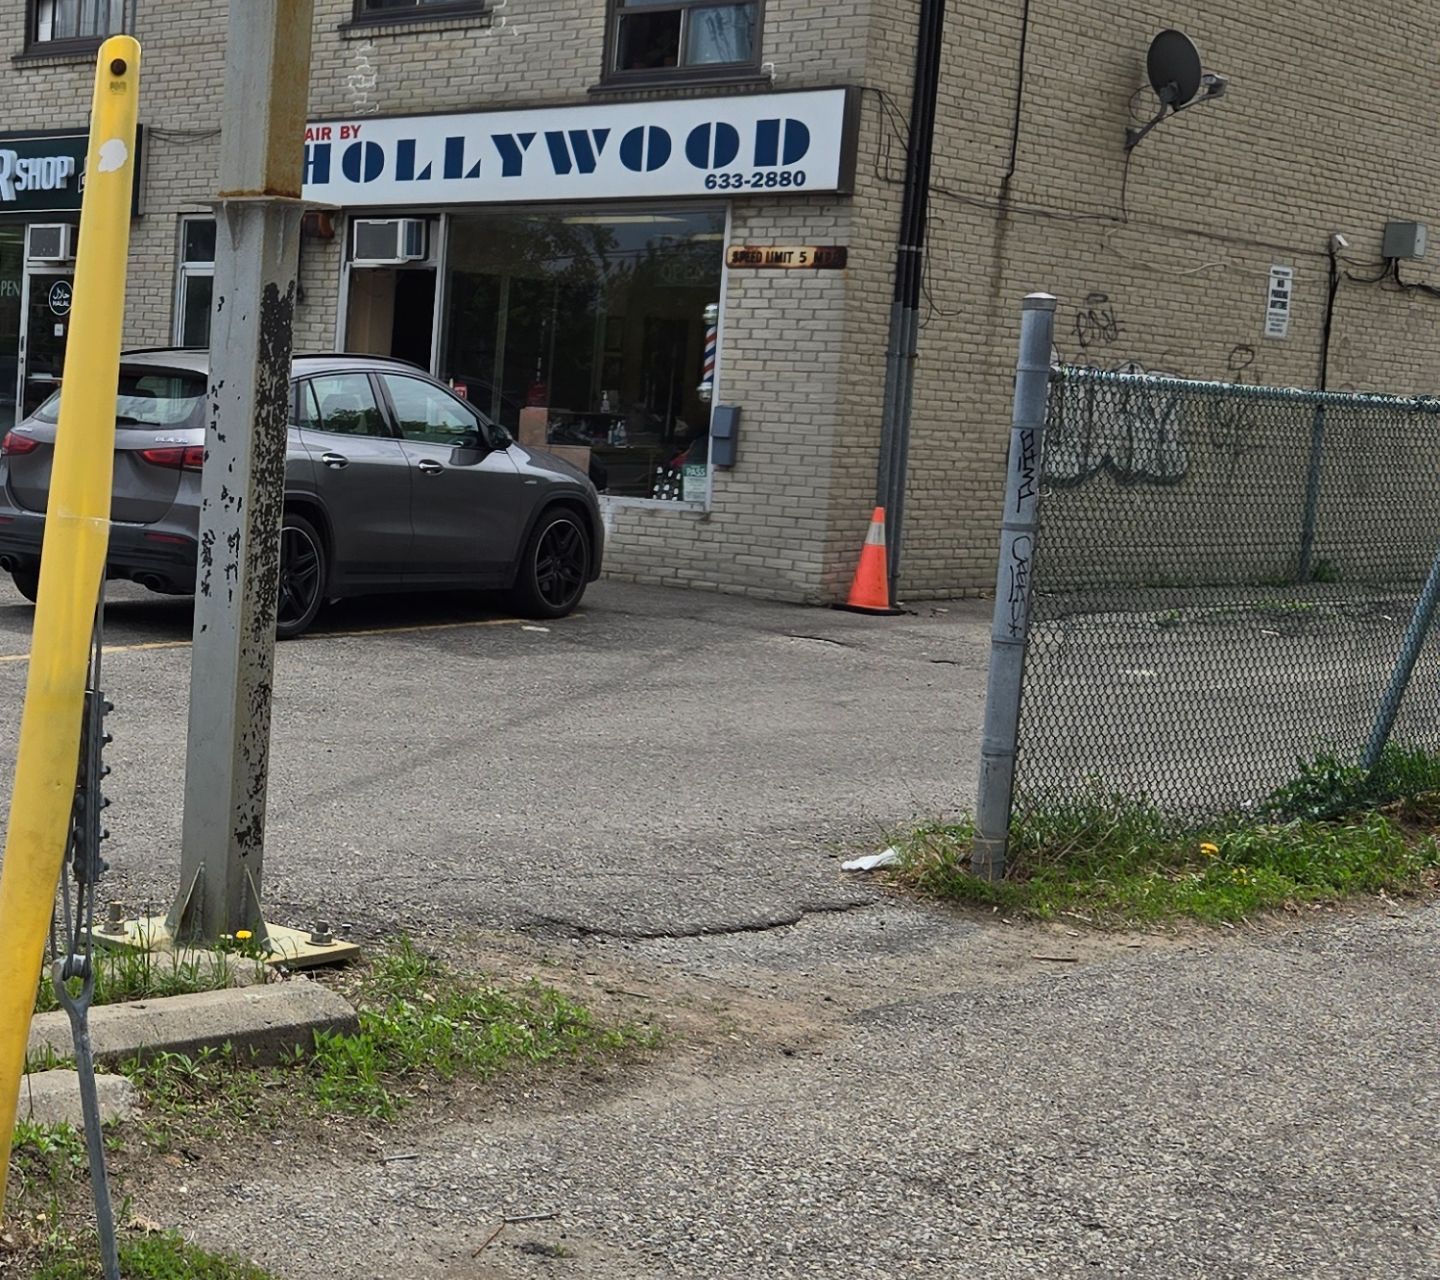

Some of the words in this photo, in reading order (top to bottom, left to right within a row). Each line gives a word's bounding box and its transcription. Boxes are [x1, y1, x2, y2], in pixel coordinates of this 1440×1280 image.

[304, 127, 331, 141] AIR
[340, 124, 361, 139] BY
[302, 118, 811, 184] HOLLYWOOD
[15, 156, 74, 191] SHOP
[704, 170, 806, 189] 633-2880
[732, 250, 762, 264] SPEED
[765, 250, 794, 264] LIMIT
[799, 251, 807, 263] 5
